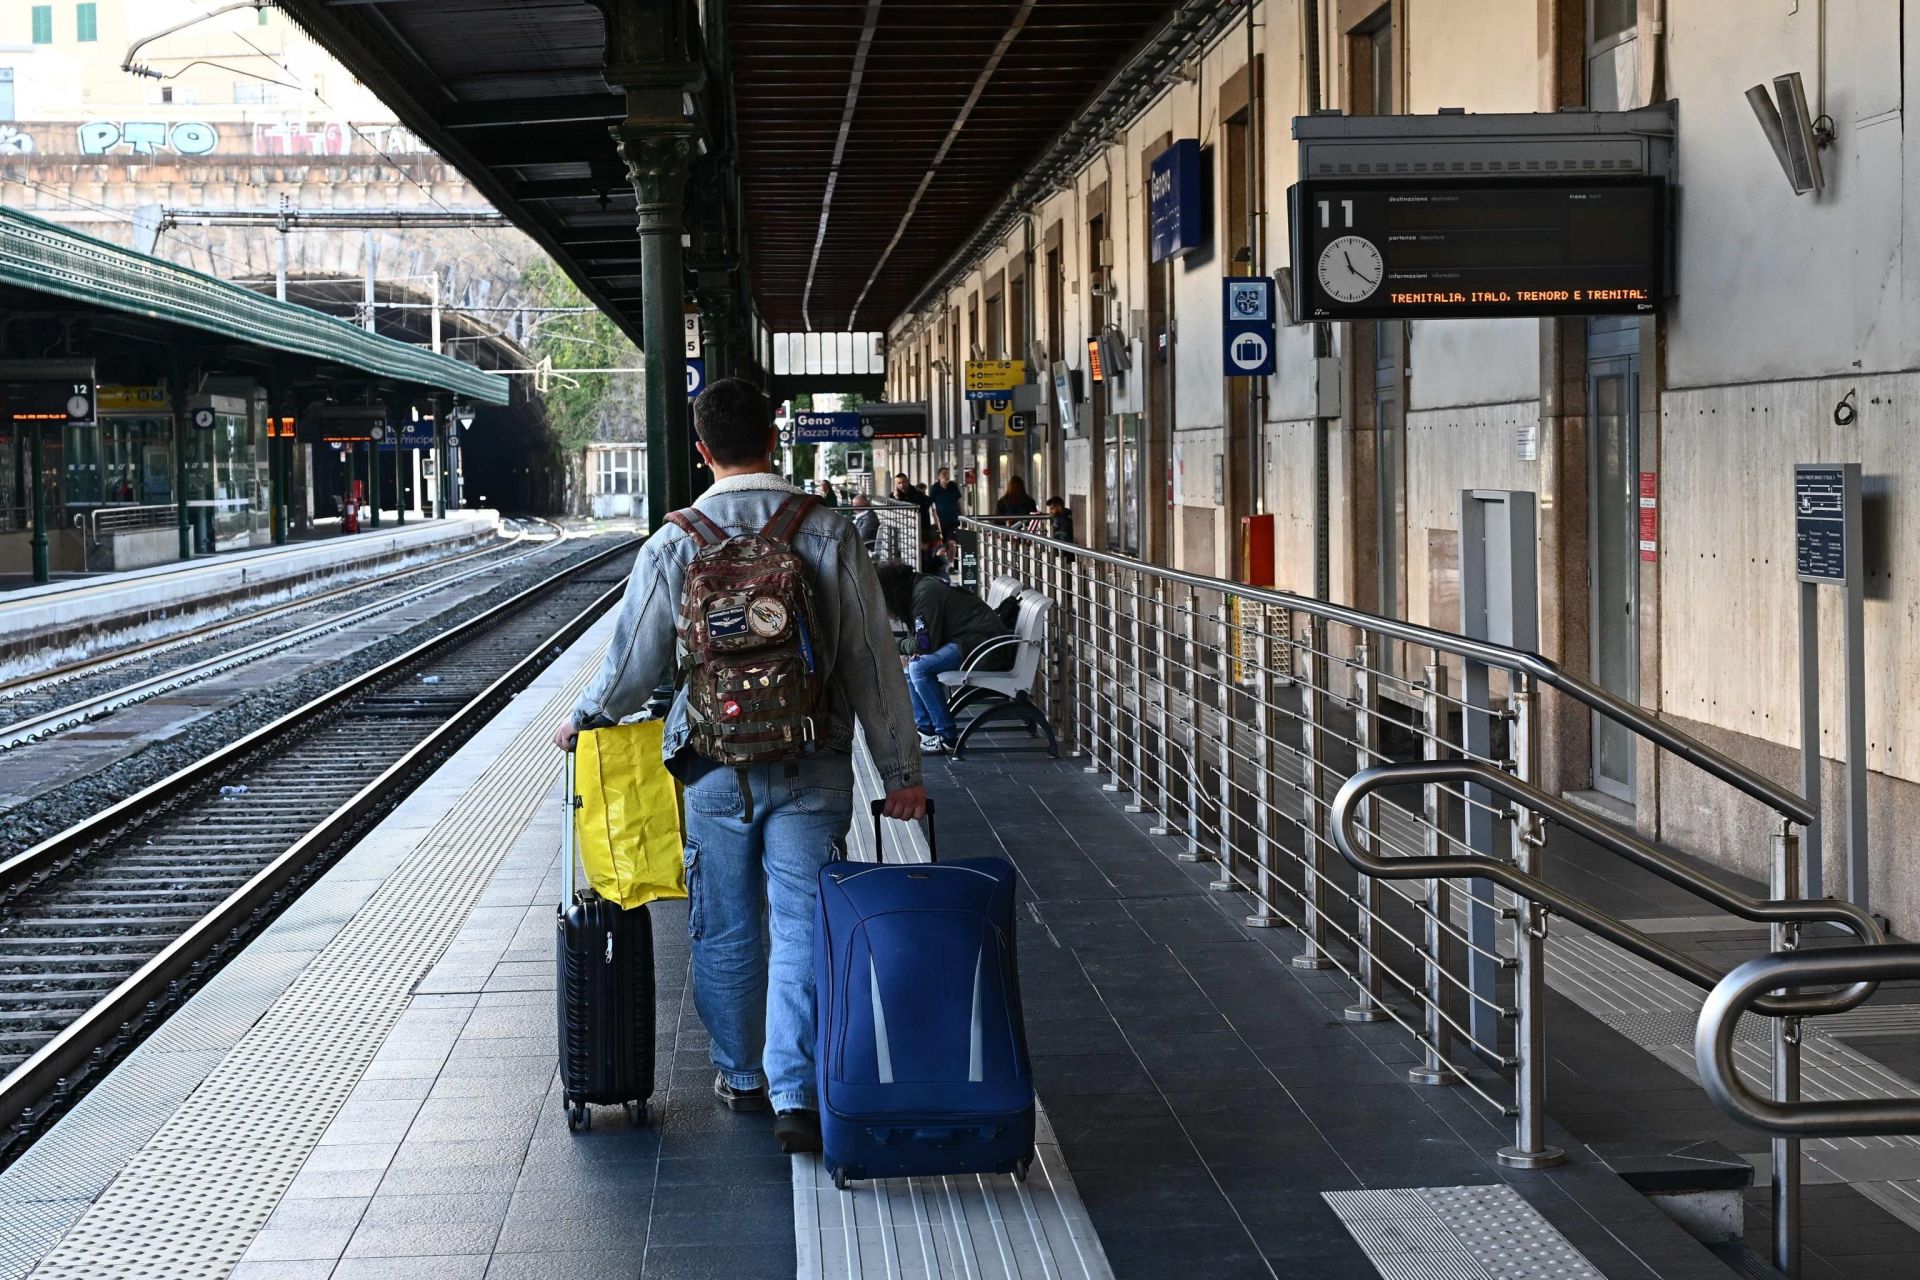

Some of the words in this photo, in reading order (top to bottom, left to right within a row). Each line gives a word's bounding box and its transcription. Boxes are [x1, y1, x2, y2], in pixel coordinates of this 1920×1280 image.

[78, 121, 218, 155] PTO
[1318, 200, 1353, 228] 11
[1391, 292, 1466, 303] TRENITALIA,
[1471, 291, 1511, 302] ITALO,
[1516, 291, 1569, 301] TRENORD
[1574, 290, 1581, 300] E
[73, 384, 88, 394] 12
[797, 427, 829, 438] Piazza
